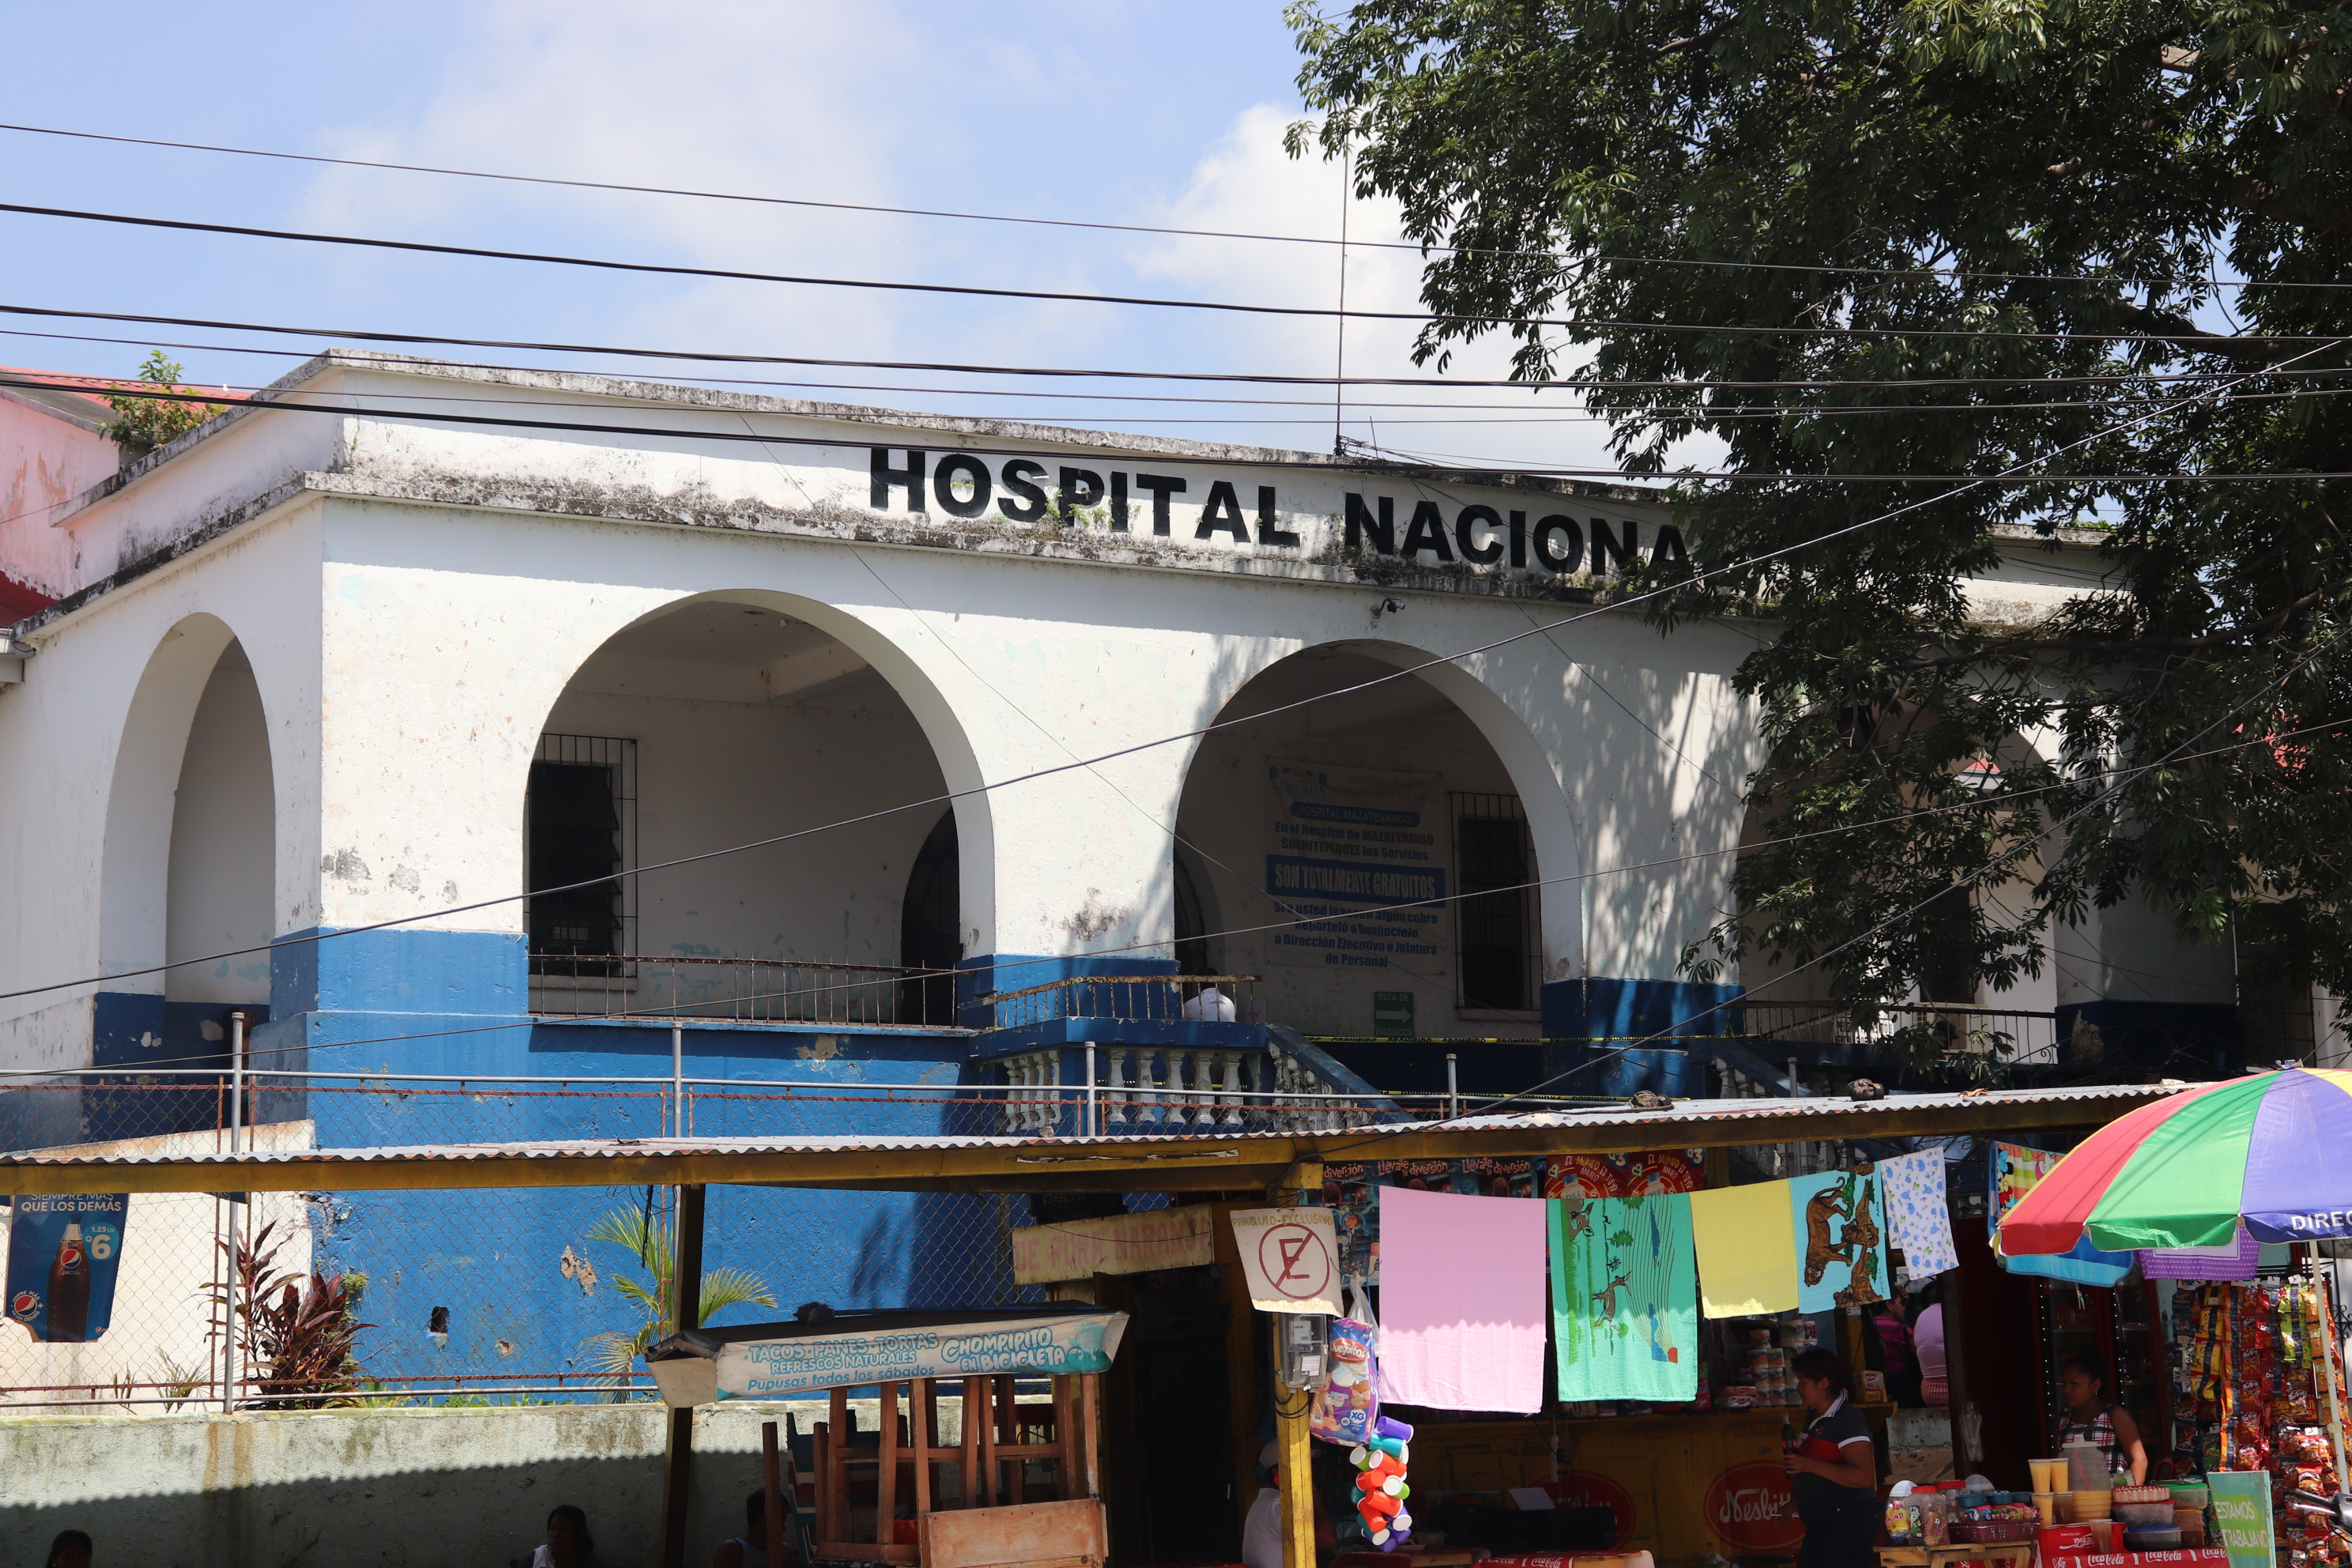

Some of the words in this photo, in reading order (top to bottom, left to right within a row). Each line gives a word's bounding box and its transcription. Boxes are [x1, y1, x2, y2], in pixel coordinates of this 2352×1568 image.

[870, 447, 1300, 546] HOSPITAL
[1344, 492, 1692, 578] NACIONA
[1272, 780, 1325, 797] GUATEMALA
[1348, 775, 1389, 787] MINISTERIO
[1371, 790, 1412, 801] ASISTENCIA
[1299, 805, 1341, 819] HOSPITAL
[1344, 811, 1412, 824] MAZATENANGO
[1275, 821, 1288, 834] En
[1290, 823, 1299, 835] el
[1302, 824, 1344, 839] hospital
[1347, 827, 1359, 840] de
[1363, 830, 1434, 846] MAZATENANGO
[1281, 837, 1360, 856] SUCHITEPÉQUEZ
[1363, 846, 1379, 857] los
[1381, 846, 1429, 861] Servicios
[1276, 863, 1299, 888] SON
[1302, 866, 1371, 895] TOTALMENTE
[1373, 872, 1436, 899] GRATUITOS
[1275, 901, 1285, 913] Si
[1296, 904, 1327, 915] usted
[1329, 906, 1339, 917] le
[1375, 910, 1405, 924] algún
[1408, 913, 1438, 925] cobro
[1359, 924, 1419, 938] Denúncielo
[1275, 935, 1281, 944] a
[1283, 934, 1336, 948] Dirección
[1337, 937, 1385, 952] Ejecutiva
[1387, 944, 1393, 952] o
[1396, 942, 1438, 955] Jefatura
[1325, 953, 1340, 964] de
[1341, 954, 1388, 968] Personal
[1378, 993, 1397, 1001] RUTA
[1399, 993, 1408, 1002] DE
[1378, 1159, 1409, 1176] Llévate
[1410, 1161, 1448, 1176] diversión
[1462, 1156, 1493, 1174] Llévate
[1494, 1160, 1531, 1175] diversión
[1565, 1156, 1573, 1167] EL
[1576, 1155, 1600, 1170] MUNDO
[1599, 1166, 1607, 1176] ES
[1605, 1173, 1619, 1192] TUYO
[1580, 1166, 1600, 1182] ÁMALO
[1648, 1154, 1656, 1164] EL
[1659, 1154, 1679, 1169] MUNDO
[1678, 1164, 1686, 1174] ES
[1683, 1170, 1694, 1189] TUYO
[1663, 1164, 1679, 1179] ÁMALO
[21, 1202, 47, 1212] QUE
[51, 1202, 75, 1212] LOS
[78, 1198, 122, 1212] DEMÁS
[1013, 1238, 1040, 1272] DE
[1114, 1217, 1212, 1261] NARANJA
[749, 1343, 805, 1363] TACOS
[813, 1337, 869, 1358] PANES
[875, 1332, 939, 1352] TORTAS
[941, 1326, 1053, 1363] CHOMPIPITO
[771, 1357, 842, 1375] REFRESCOS
[844, 1351, 917, 1368] NATURALES
[960, 1356, 979, 1373] EN
[979, 1346, 1065, 1373] BICICLETA
[748, 1378, 807, 1392] Pupusas
[812, 1372, 850, 1385] todos
[854, 1370, 873, 1381] los
[878, 1365, 934, 1378] sábados
[1351, 1412, 1364, 1420] XG
[2214, 1502, 2255, 1520] ESTAMOS
